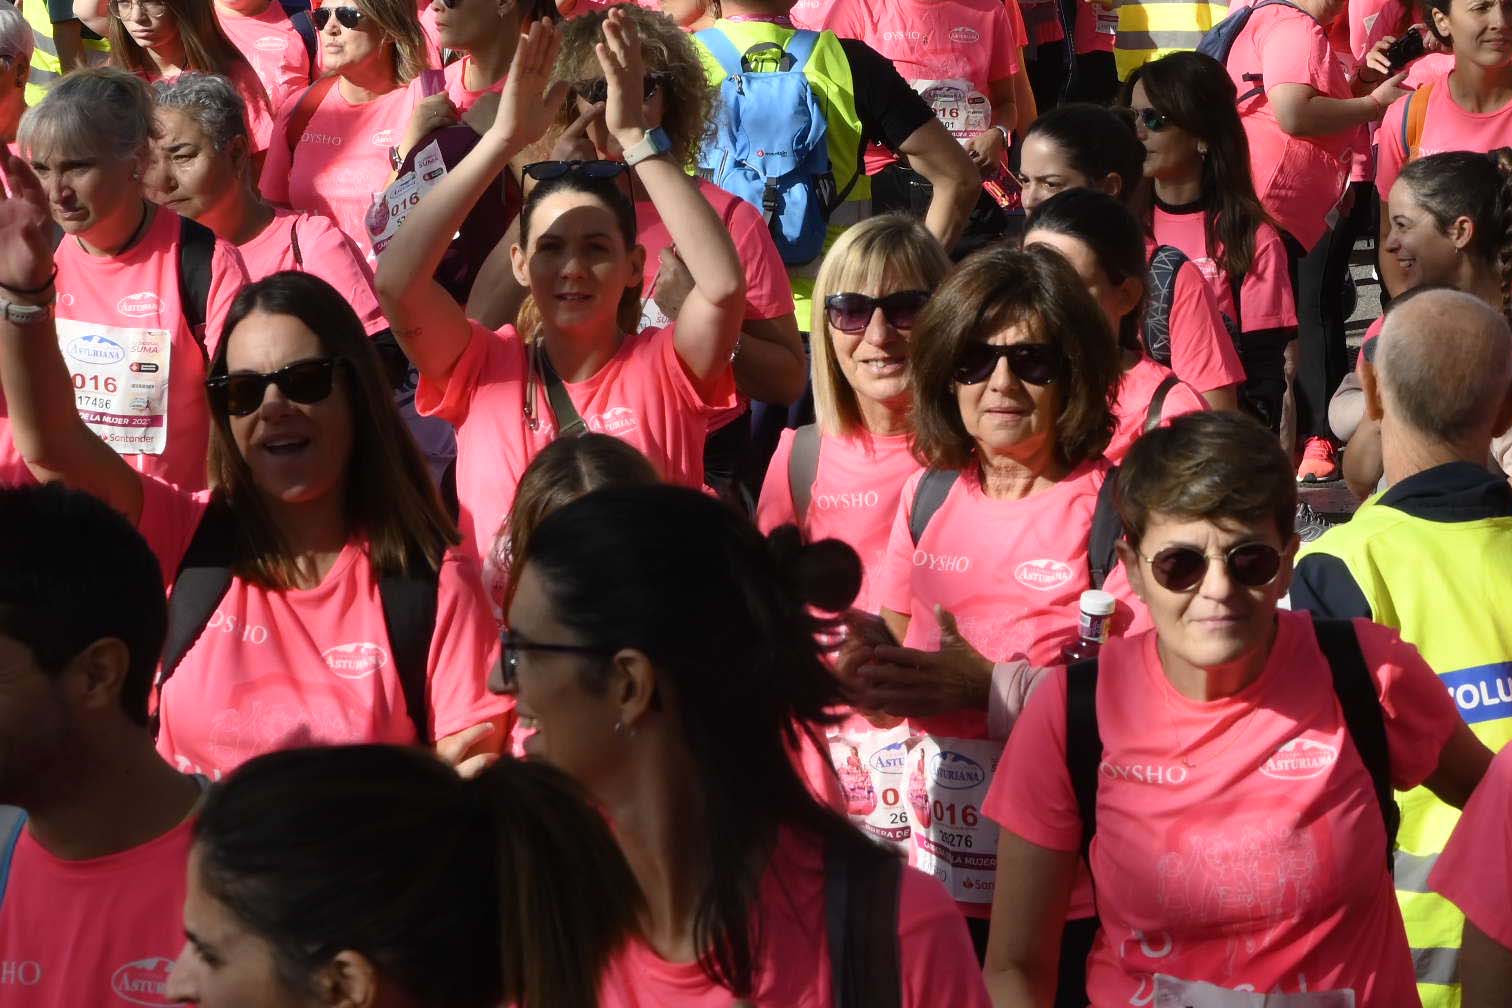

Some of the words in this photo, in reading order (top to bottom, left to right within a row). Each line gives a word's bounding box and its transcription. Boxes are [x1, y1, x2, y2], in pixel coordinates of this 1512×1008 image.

[391, 191, 420, 217] 016
[131, 345, 160, 354] SUMA
[73, 373, 118, 394] 016
[89, 413, 100, 422] LA
[102, 415, 129, 425] MUJER
[110, 432, 155, 445] Santander
[817, 490, 879, 510] OYSHO
[912, 549, 971, 573] OYSHO
[1100, 761, 1188, 784] OYSHO
[1267, 753, 1332, 772] ASTURIANA
[933, 799, 978, 827] 016
[975, 879, 996, 890] San
